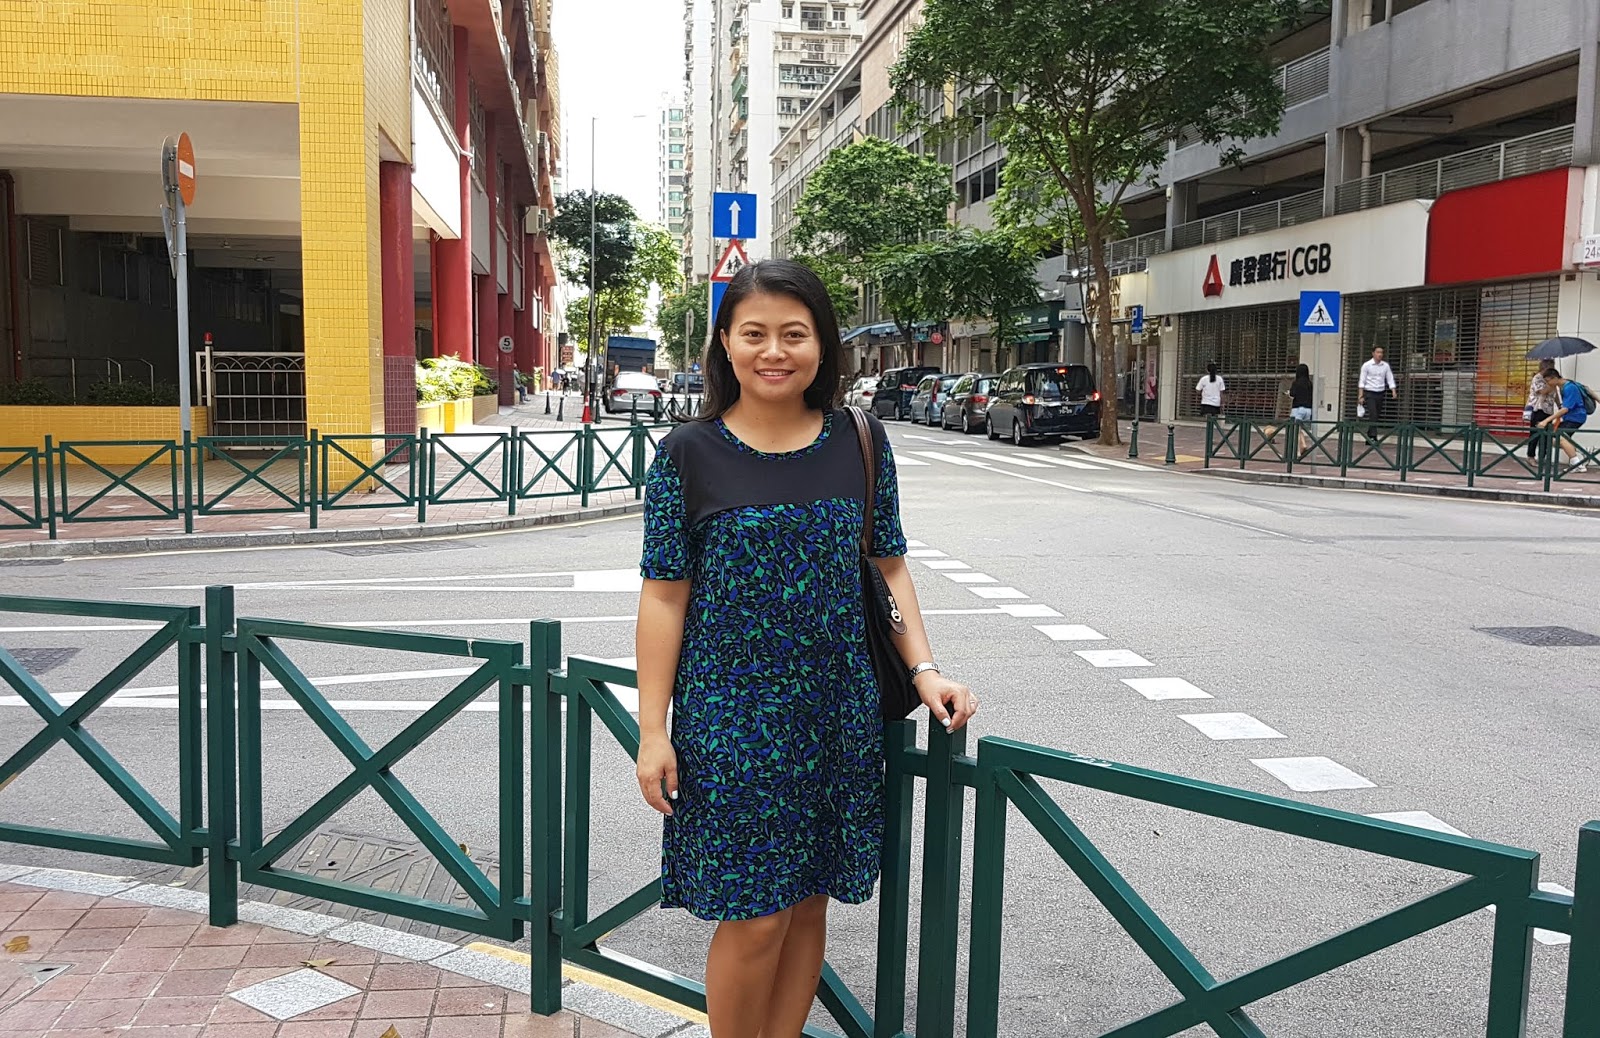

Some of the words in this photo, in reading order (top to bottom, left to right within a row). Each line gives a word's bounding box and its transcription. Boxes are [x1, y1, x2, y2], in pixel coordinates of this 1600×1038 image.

[1292, 243, 1332, 277] CGB
[1585, 246, 1596, 259] 24
[1229, 251, 1287, 286] 廣發銀行
[504, 337, 511, 346] 5
